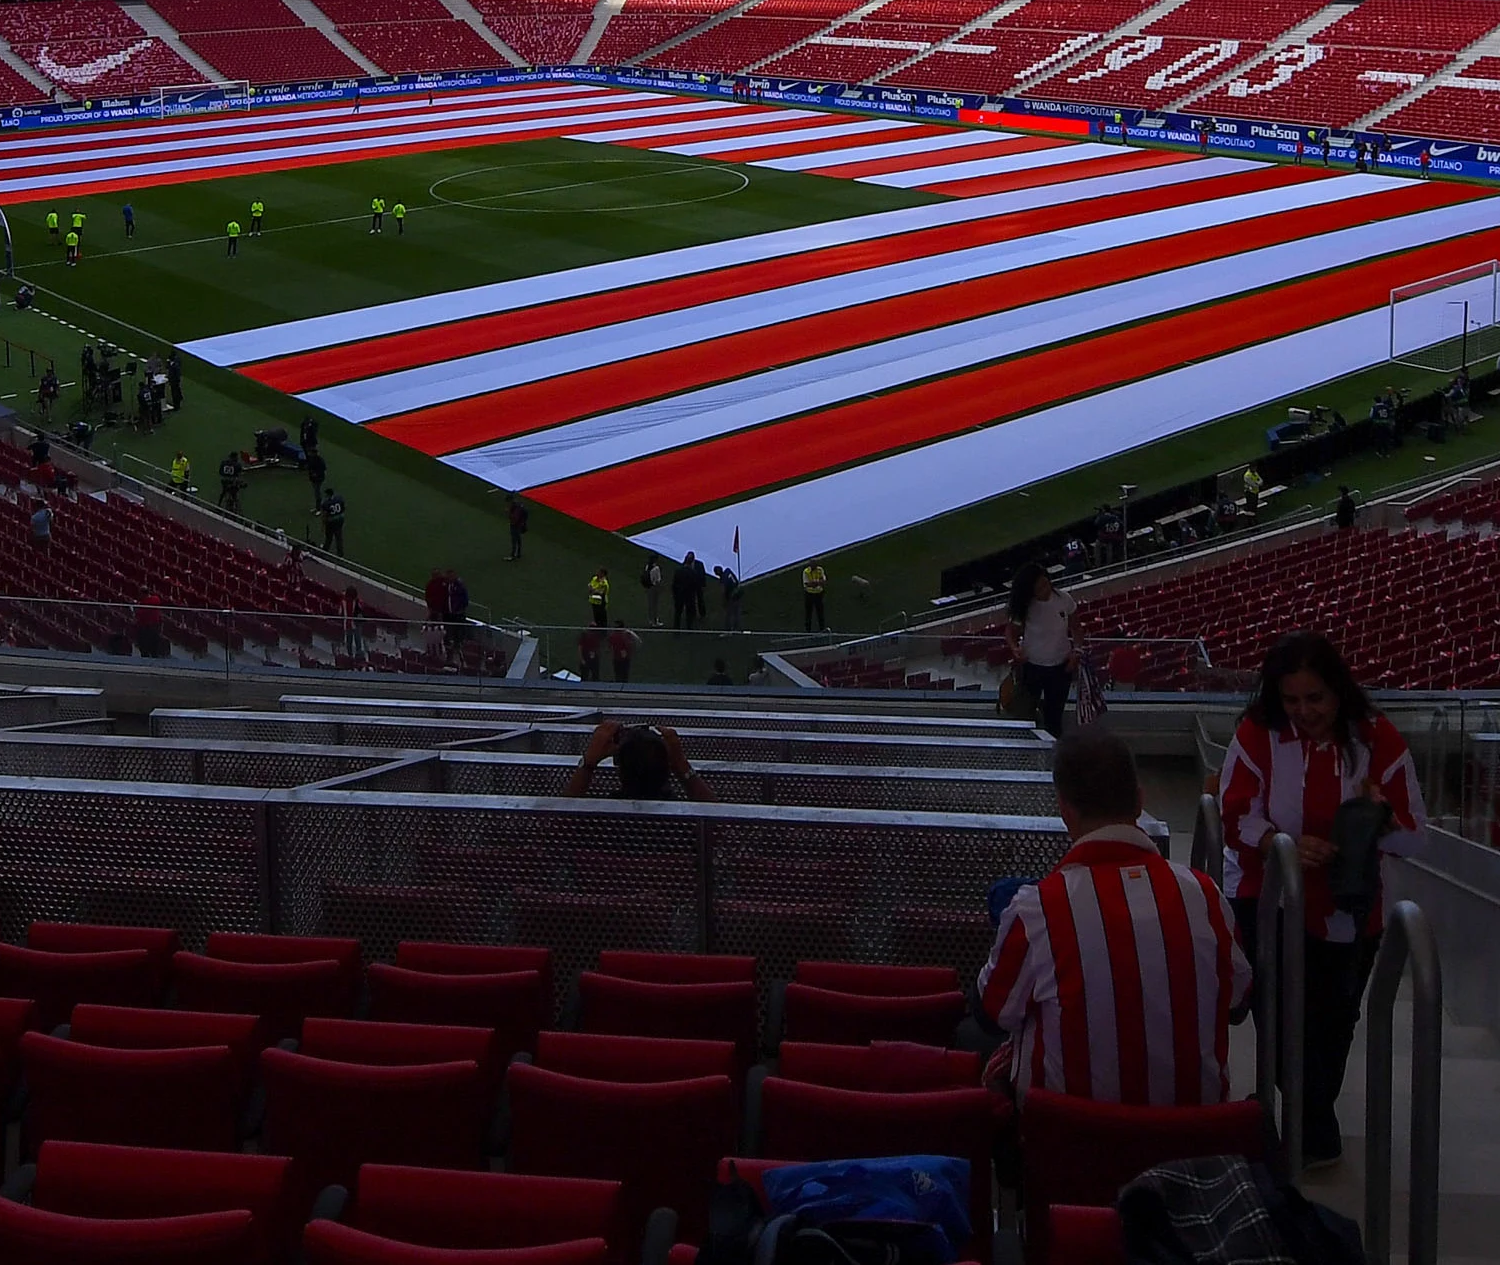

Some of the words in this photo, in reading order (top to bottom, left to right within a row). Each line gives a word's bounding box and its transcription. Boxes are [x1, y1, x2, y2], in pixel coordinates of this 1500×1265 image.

[1014, 33, 1324, 96] 1903
[748, 79, 770, 89] bwin
[885, 102, 907, 111] WANDA
[1032, 101, 1061, 112] WANDA
[40, 114, 63, 124] PROUD
[64, 112, 93, 122] SPONSOR
[93, 111, 103, 119] OF
[110, 107, 139, 117] WANDA
[1149, 130, 1158, 139] OF
[1167, 131, 1196, 142] WANDA
[1250, 126, 1300, 141] Plus500
[1277, 143, 1297, 153] PROU
[1337, 149, 1347, 158] OF
[1393, 152, 1463, 171] METROOLITANO
[329, 502, 341, 514] 30
